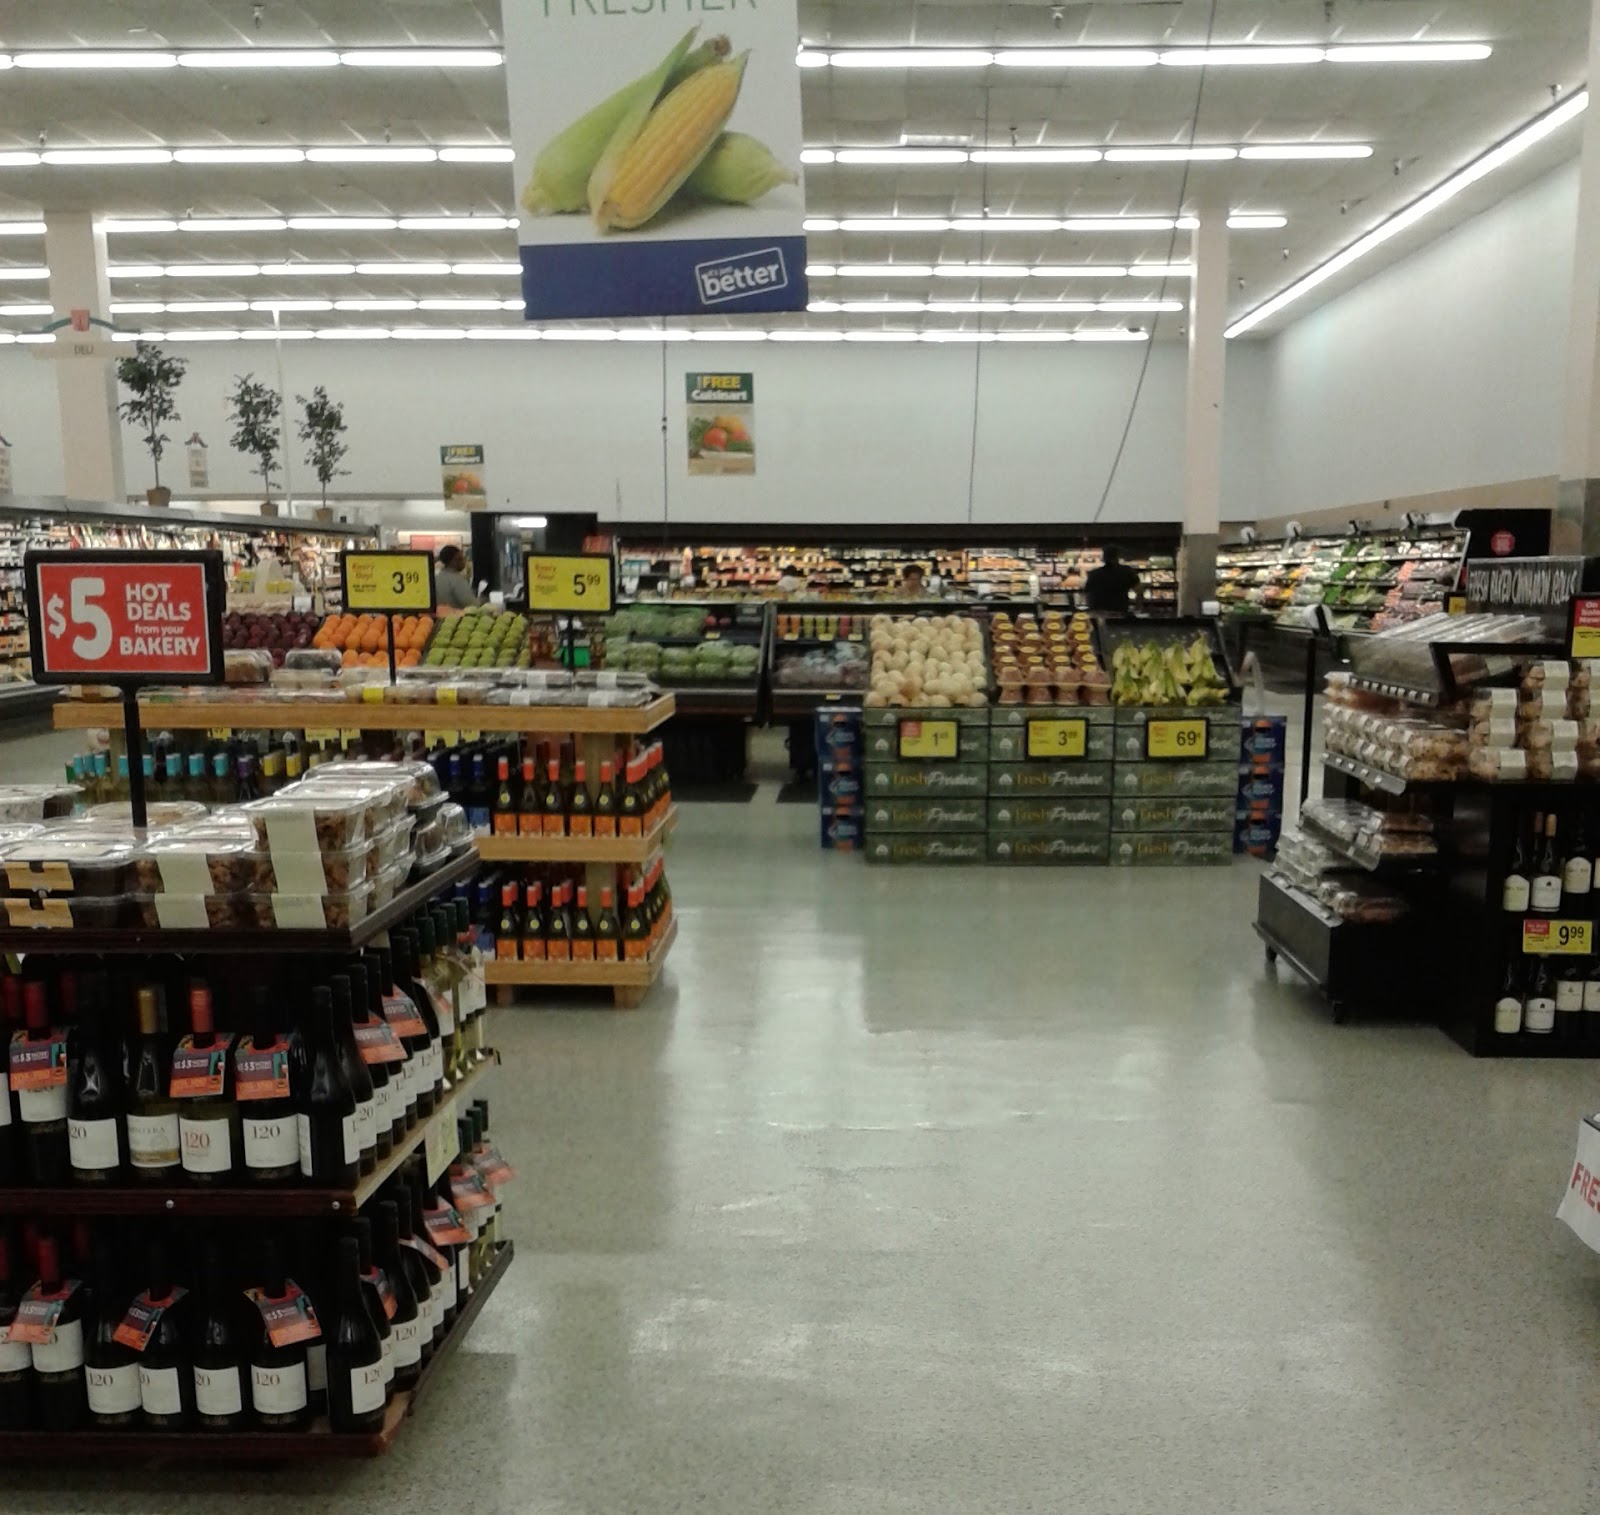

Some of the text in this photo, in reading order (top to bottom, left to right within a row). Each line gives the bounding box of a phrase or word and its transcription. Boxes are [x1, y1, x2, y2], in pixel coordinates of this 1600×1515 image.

[702, 264, 779, 296] better
[125, 582, 172, 601] HOT
[46, 576, 114, 661] $5
[127, 602, 192, 621] DEALS
[135, 624, 185, 637] from your
[119, 636, 200, 656] BAKERY
[184, 1130, 210, 1149] 120
[253, 1124, 280, 1140] 120
[395, 1326, 416, 1341] 120
[89, 1373, 114, 1387] 120
[256, 1372, 281, 1387] 120
